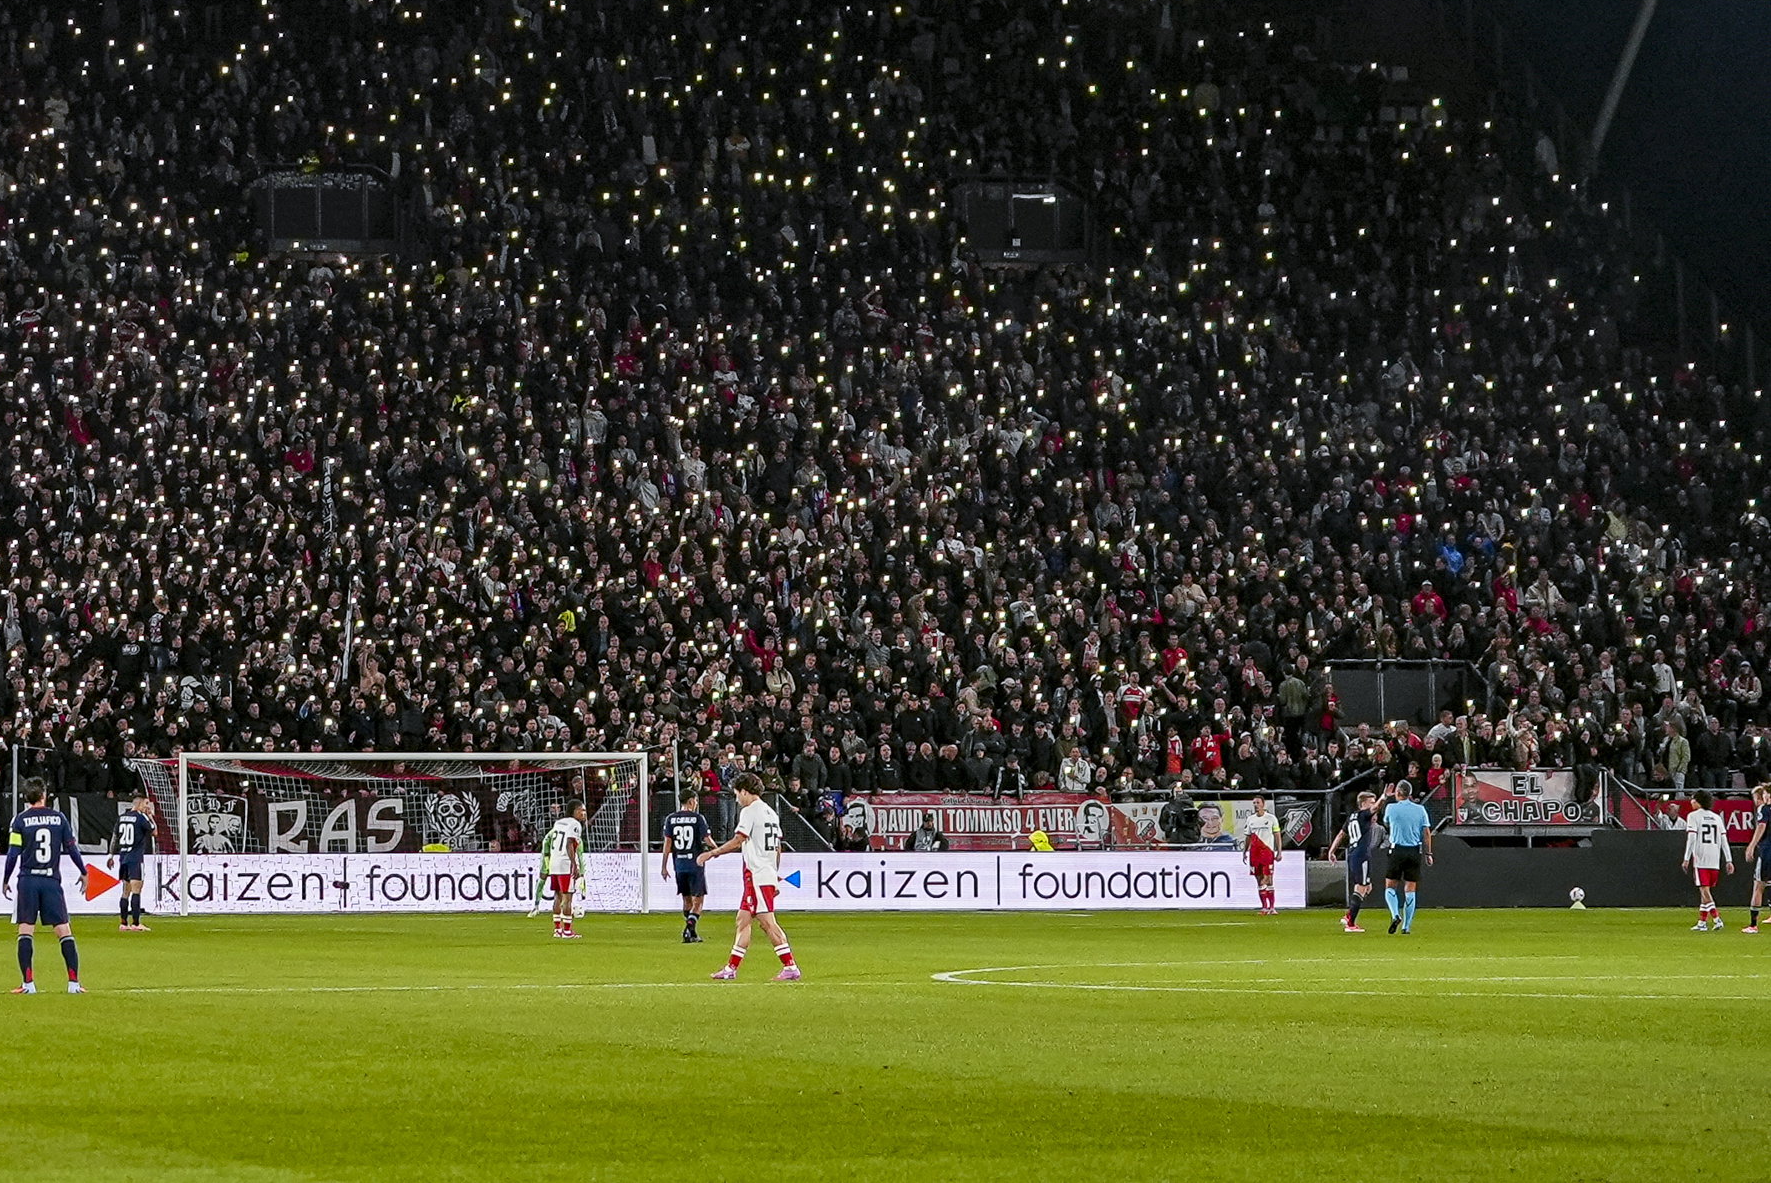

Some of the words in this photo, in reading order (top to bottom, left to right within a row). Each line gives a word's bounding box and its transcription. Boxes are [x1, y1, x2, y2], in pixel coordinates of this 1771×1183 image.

[1511, 773, 1543, 797] EL
[23, 815, 62, 827] TAGLIAFICO
[878, 808, 923, 833] DAVID
[947, 808, 1022, 833] TOMMASO
[1025, 808, 1036, 832] 4
[1039, 808, 1076, 832] EVER
[1481, 800, 1582, 822] CHAPO
[35, 828, 53, 864] 3
[119, 823, 135, 845] 20
[673, 825, 694, 850] 39
[1701, 824, 1718, 844] 21
[157, 862, 325, 902] kaizen
[817, 859, 979, 899] kaizen
[1019, 862, 1231, 899] foundation
